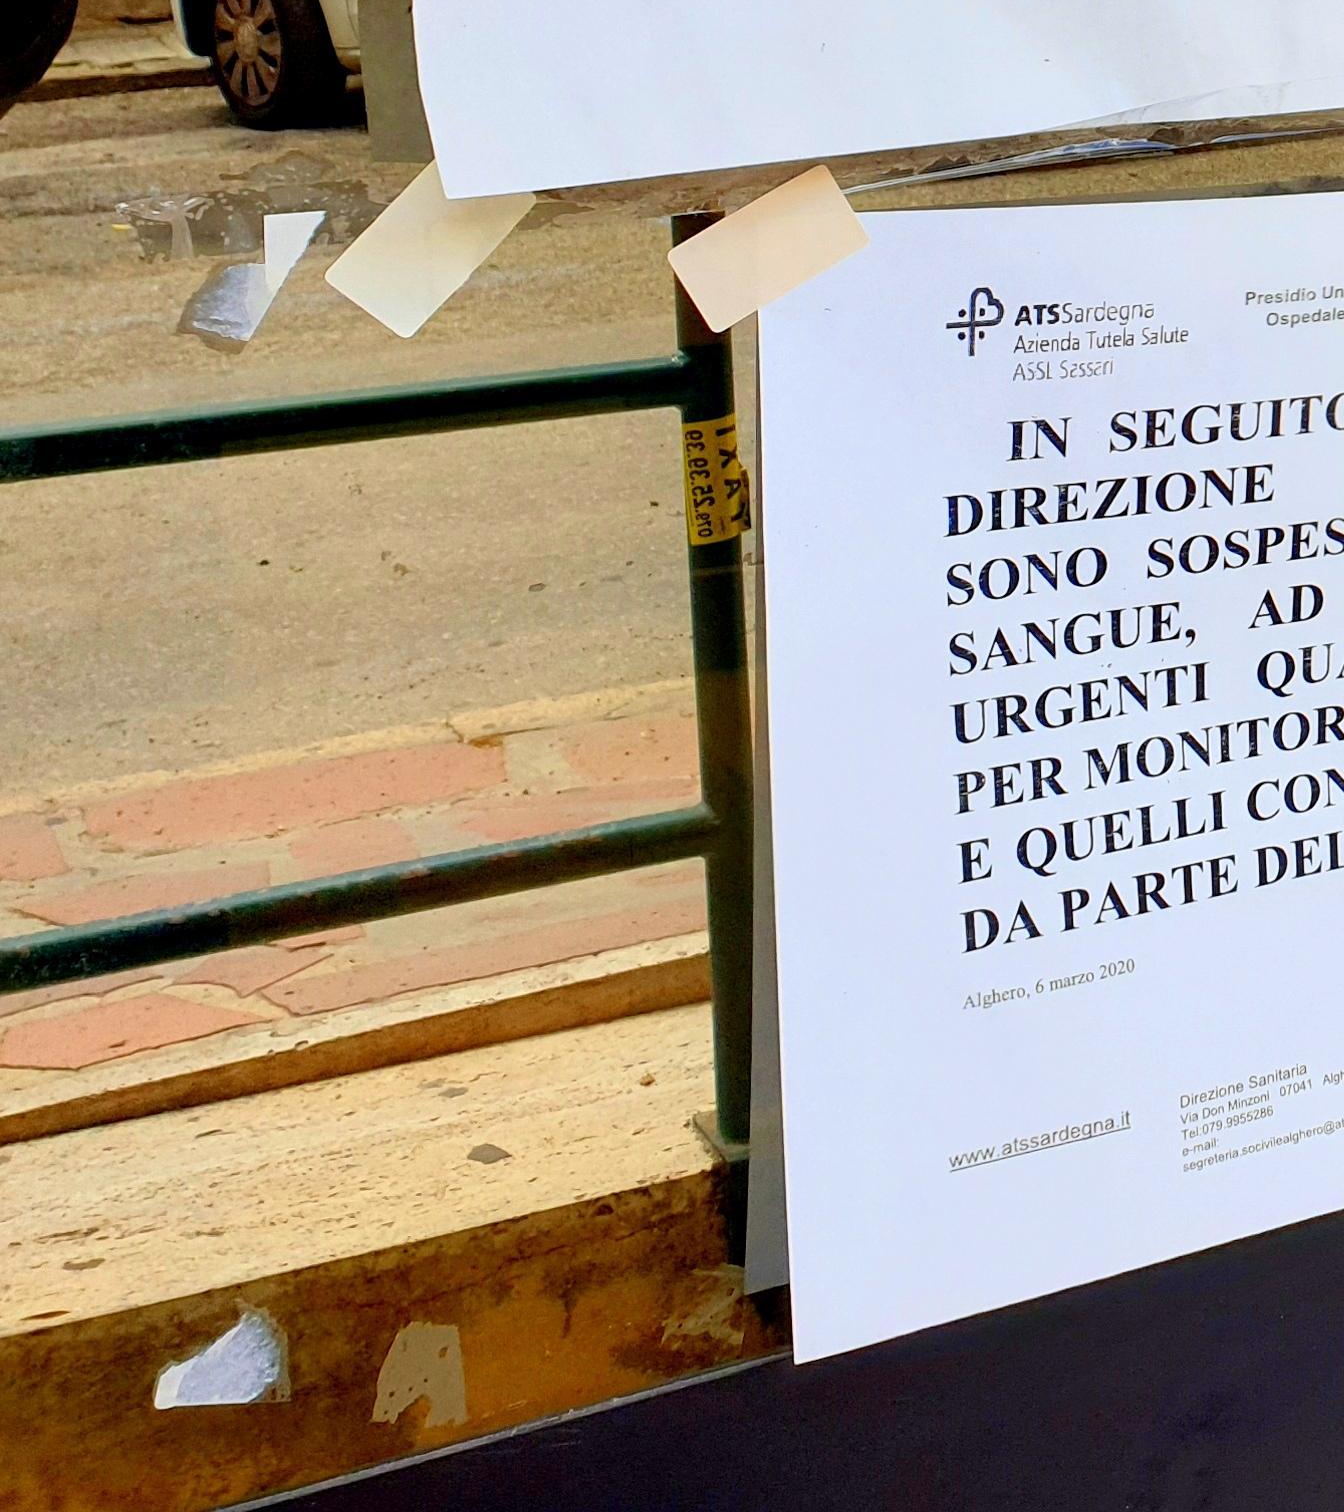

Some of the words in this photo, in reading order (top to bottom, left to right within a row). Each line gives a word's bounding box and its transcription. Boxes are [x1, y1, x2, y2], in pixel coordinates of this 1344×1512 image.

[1245, 288, 1316, 305] Presidio
[1013, 333, 1080, 354] Azienda
[1087, 330, 1134, 349] Tutela
[1142, 326, 1188, 345] Salute
[1012, 362, 1052, 381] ASSL
[1059, 357, 1114, 379] Sassari
[1007, 415, 1072, 462] IN
[943, 464, 1275, 538] DIREZIONE
[946, 546, 1108, 607] SONO
[949, 601, 1197, 677] SANGUE,
[1249, 584, 1323, 629] AD
[950, 662, 1210, 745] URGENTI
[954, 756, 1068, 815] PER
[957, 838, 992, 885] E
[1016, 791, 1225, 876] QUELLI
[961, 900, 1042, 953] DA
[1058, 855, 1239, 933] PARTE
[963, 987, 1030, 1009] Alghero,
[1035, 978, 1044, 994] 6
[1050, 972, 1094, 991] marzo
[1100, 959, 1135, 979] 2020
[1180, 1081, 1244, 1109] Direzione
[1249, 1064, 1308, 1089] Sanitaria
[1180, 1111, 1199, 1125] Via
[1202, 1105, 1225, 1120] Don
[1228, 1092, 1270, 1112] Minzoni
[1279, 1079, 1312, 1097] 07041
[949, 1110, 1132, 1170] www.atssardegna.it
[1182, 1138, 1219, 1157] e-mail:
